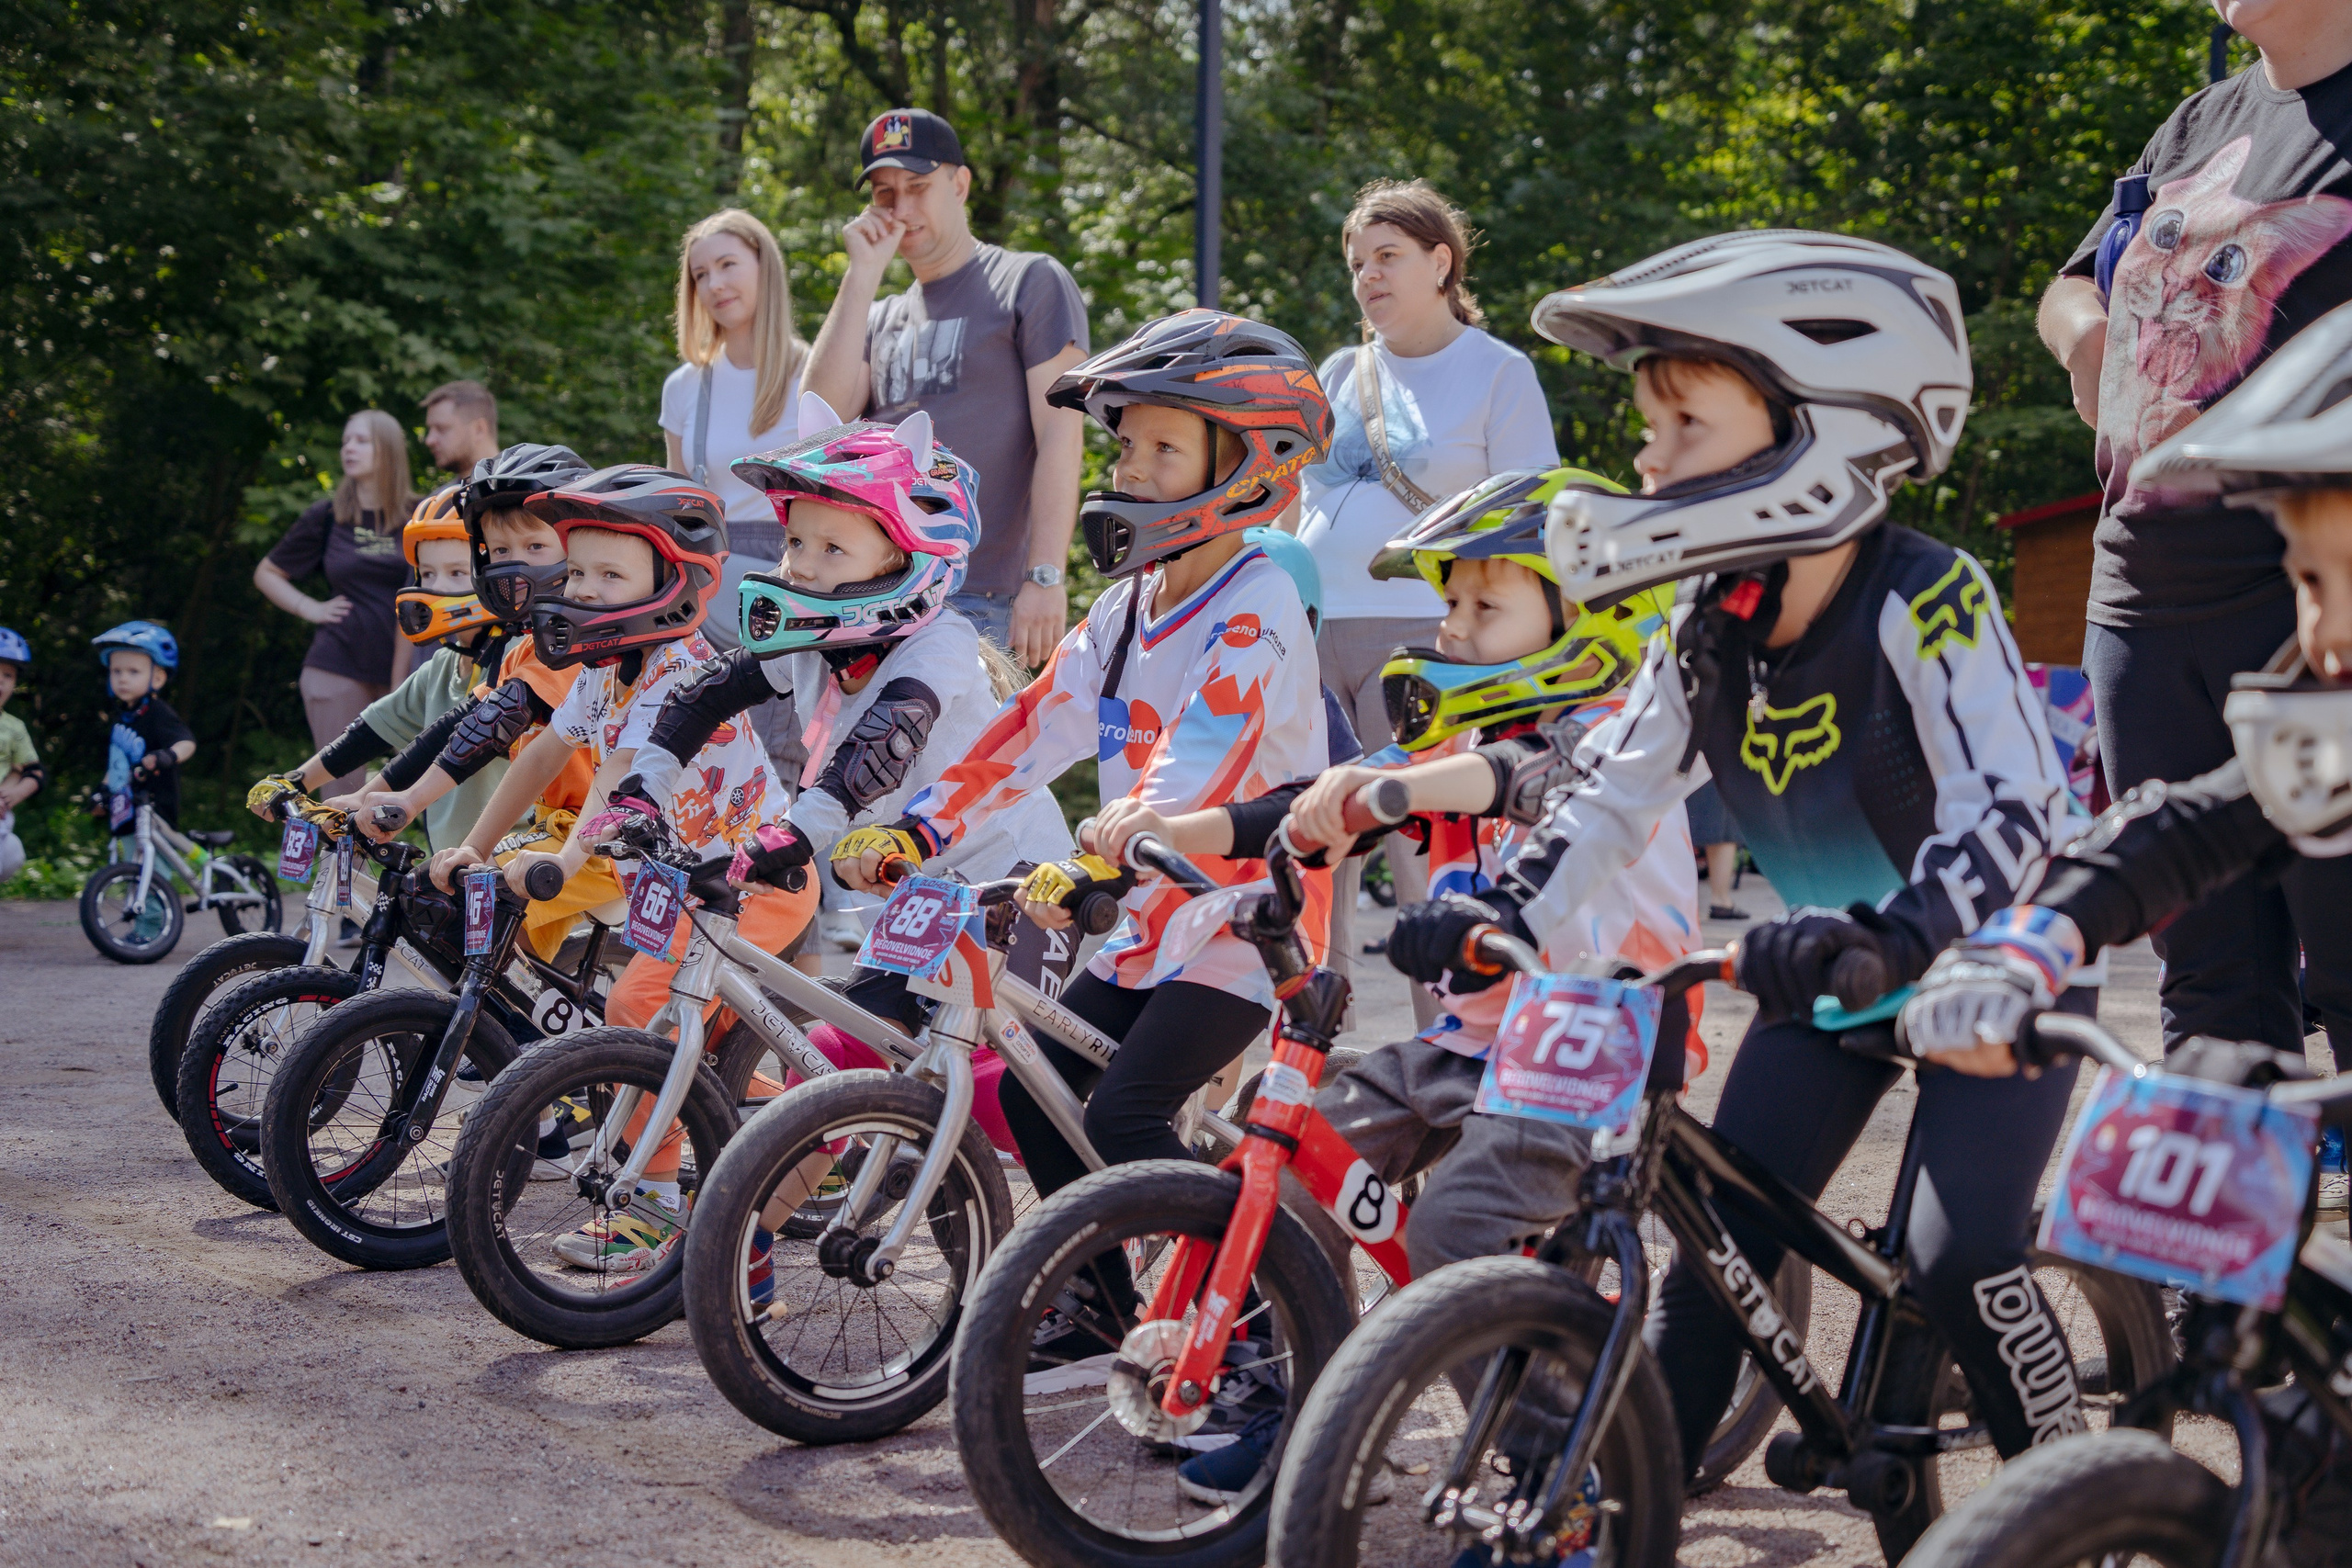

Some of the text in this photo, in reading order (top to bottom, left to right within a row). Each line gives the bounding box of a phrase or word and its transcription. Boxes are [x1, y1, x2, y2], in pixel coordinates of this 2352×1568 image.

[1785, 278, 1852, 295] JETCAT
[582, 638, 620, 651] JETCAT
[285, 829, 307, 860] 83
[641, 881, 672, 925] 66
[889, 896, 943, 938] 88
[873, 938, 935, 961] BEGOVELVIDNOE
[222, 997, 289, 1048] RACING
[541, 997, 573, 1036] 8
[1532, 1000, 1615, 1070] 75
[2118, 1124, 2234, 1217] 101
[1349, 1173, 1385, 1231] 8
